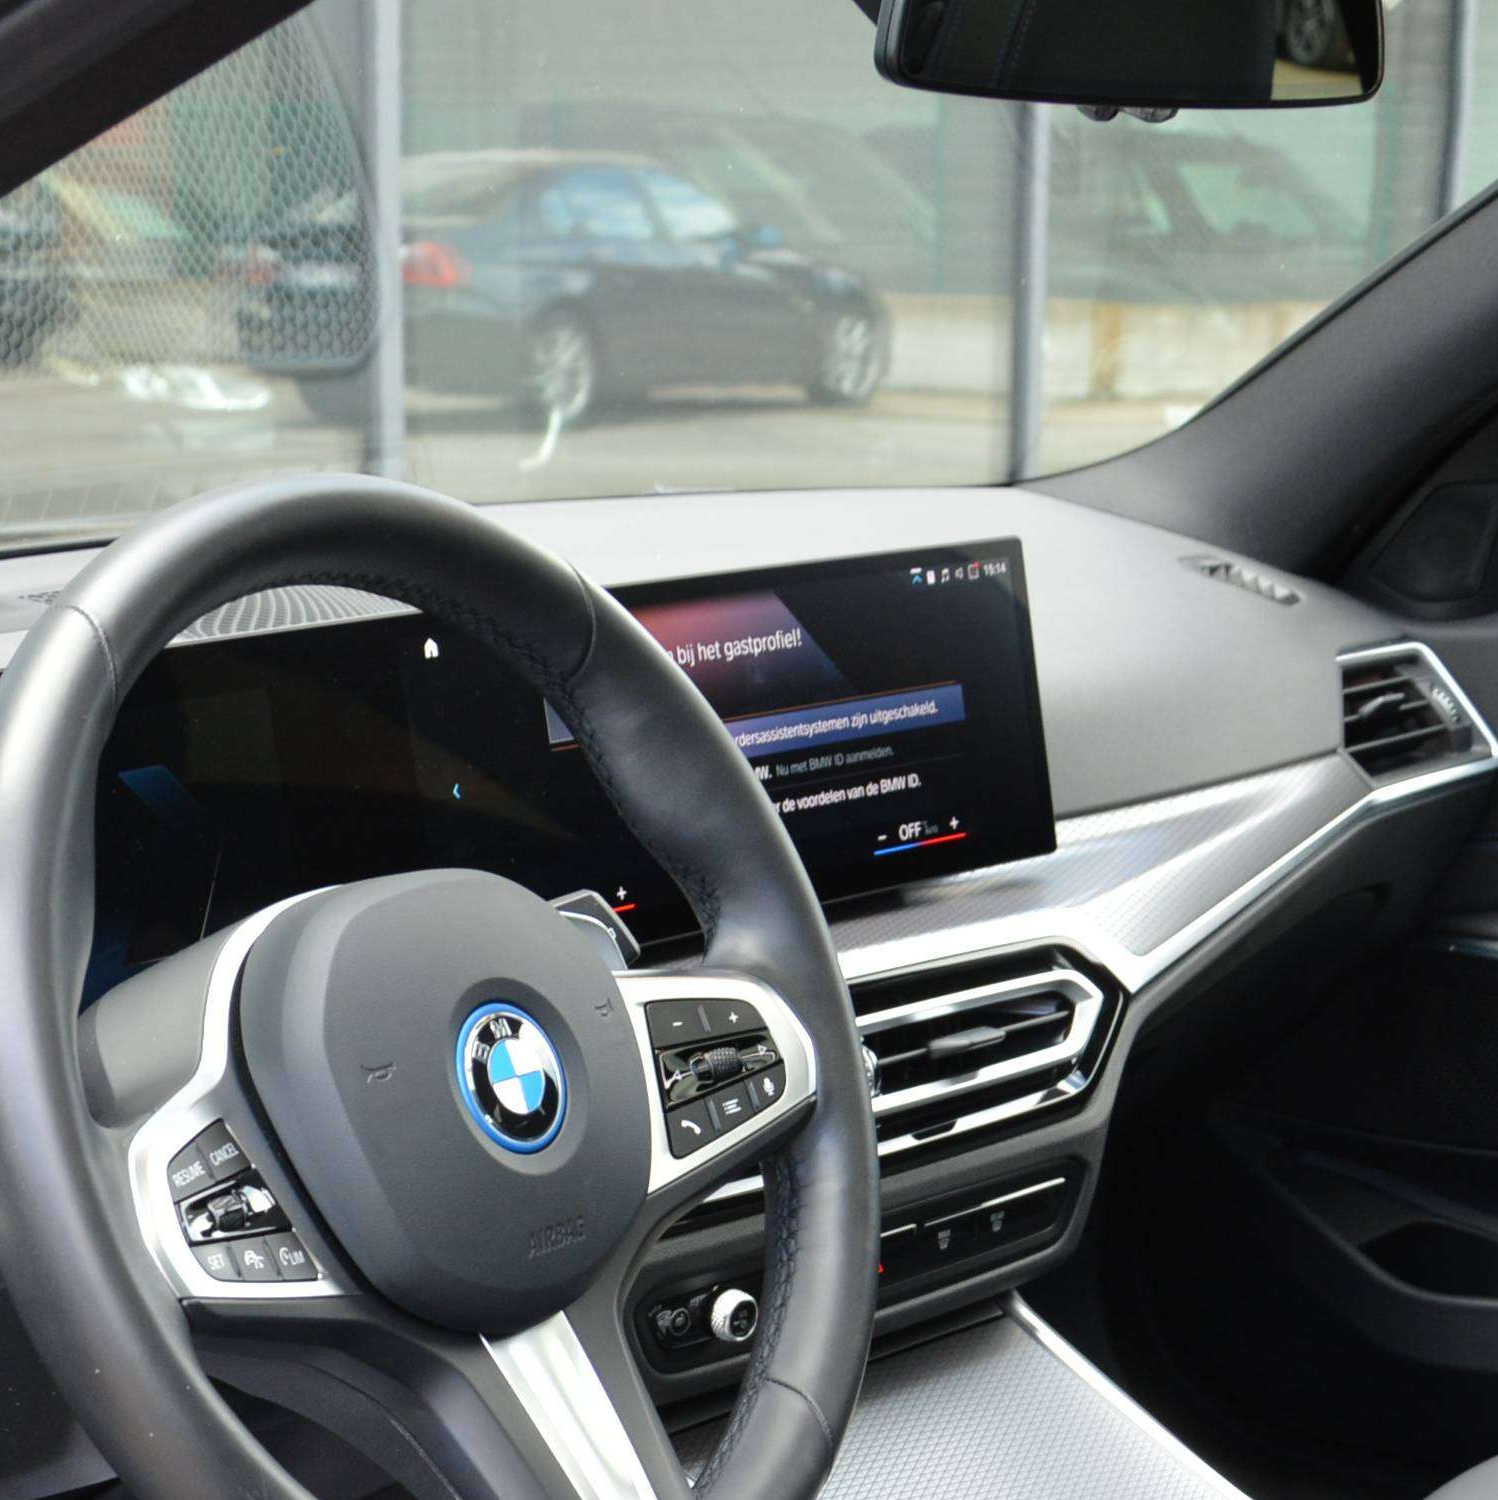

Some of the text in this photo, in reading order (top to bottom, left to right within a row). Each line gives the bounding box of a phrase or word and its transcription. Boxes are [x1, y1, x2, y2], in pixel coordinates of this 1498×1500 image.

[676, 643, 696, 668] bij
[697, 640, 721, 662] het
[723, 627, 803, 662] gastprofiel!
[851, 711, 868, 730] zijn
[869, 699, 939, 726] uitgeschakeld.
[809, 754, 833, 771] BMW
[782, 797, 797, 814] de
[797, 788, 846, 810] voordelen
[846, 785, 865, 800] van
[866, 781, 880, 797] de
[880, 775, 906, 794] BMW
[907, 772, 922, 789] ID.
[898, 820, 921, 841] OFF
[209, 1142, 240, 1166] CANCEL
[172, 1161, 206, 1188] RESUME
[207, 1253, 225, 1271] SET
